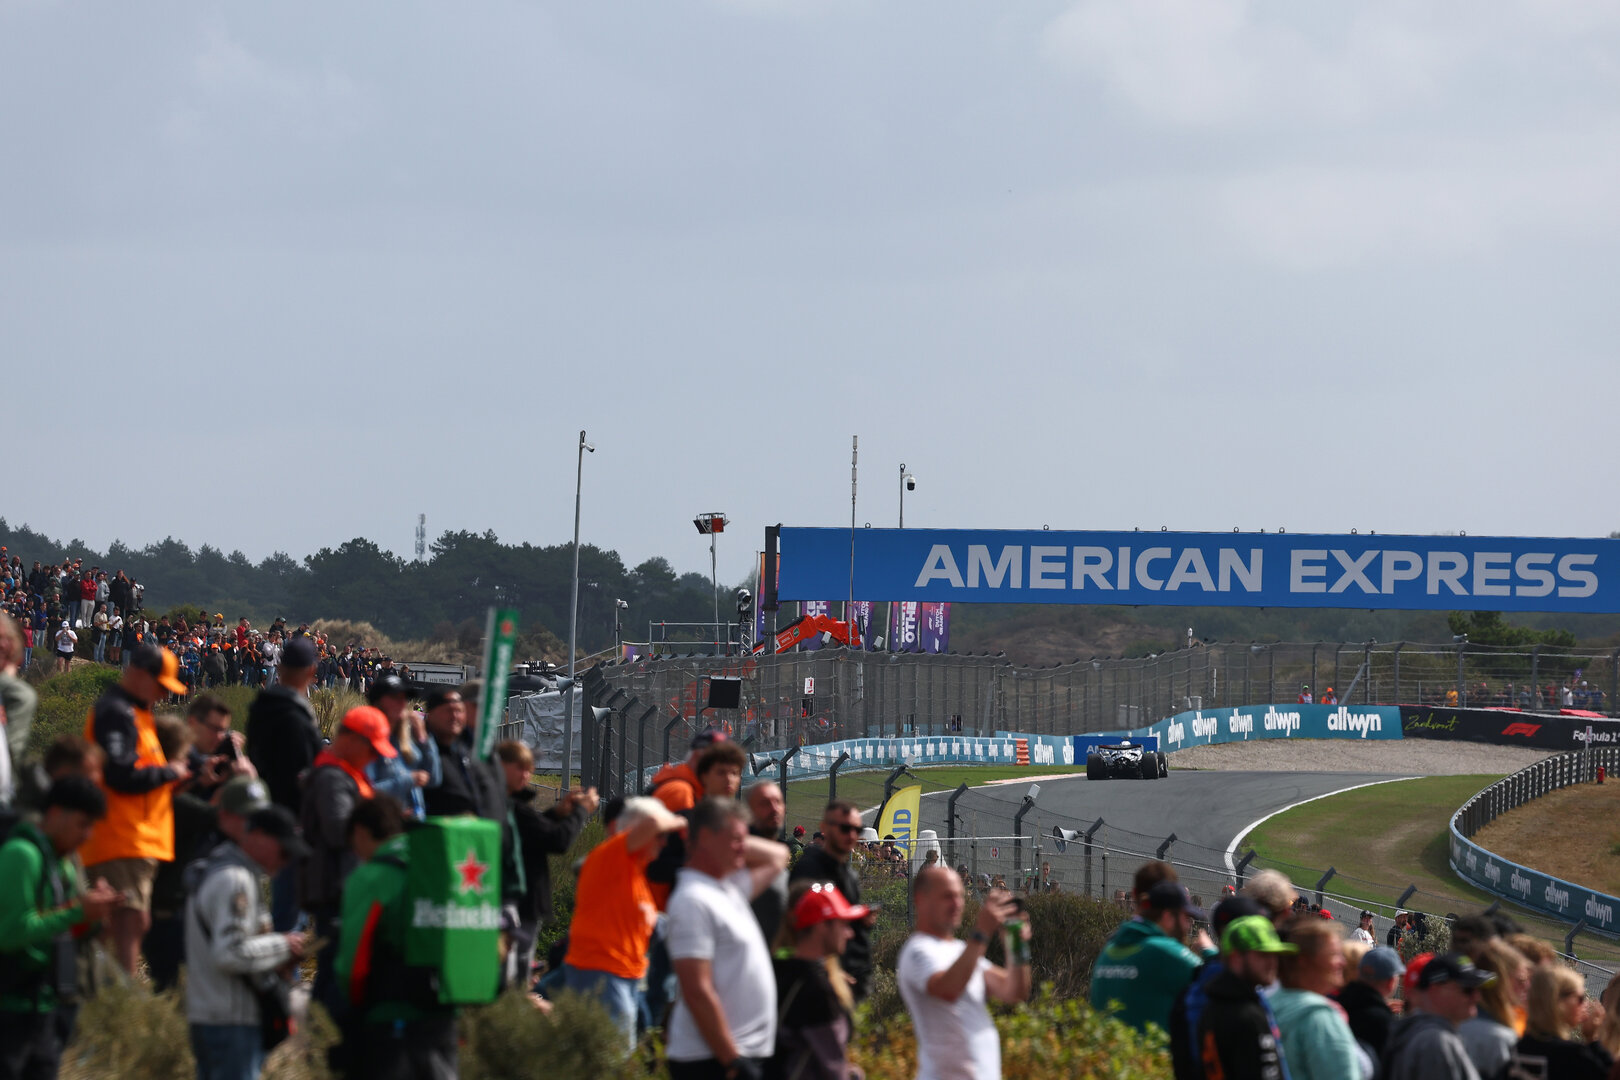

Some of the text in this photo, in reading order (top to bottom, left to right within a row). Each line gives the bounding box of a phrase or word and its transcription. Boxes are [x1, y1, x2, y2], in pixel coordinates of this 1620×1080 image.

[914, 544, 1599, 598] AMERICAN EXPRESS
[1229, 708, 1253, 740] allwyn
[1264, 706, 1300, 737] allwyn
[1327, 706, 1382, 738] allwyn
[892, 809, 911, 850] AID
[1545, 881, 1569, 912] allwyn
[1585, 894, 1612, 927] allwyn
